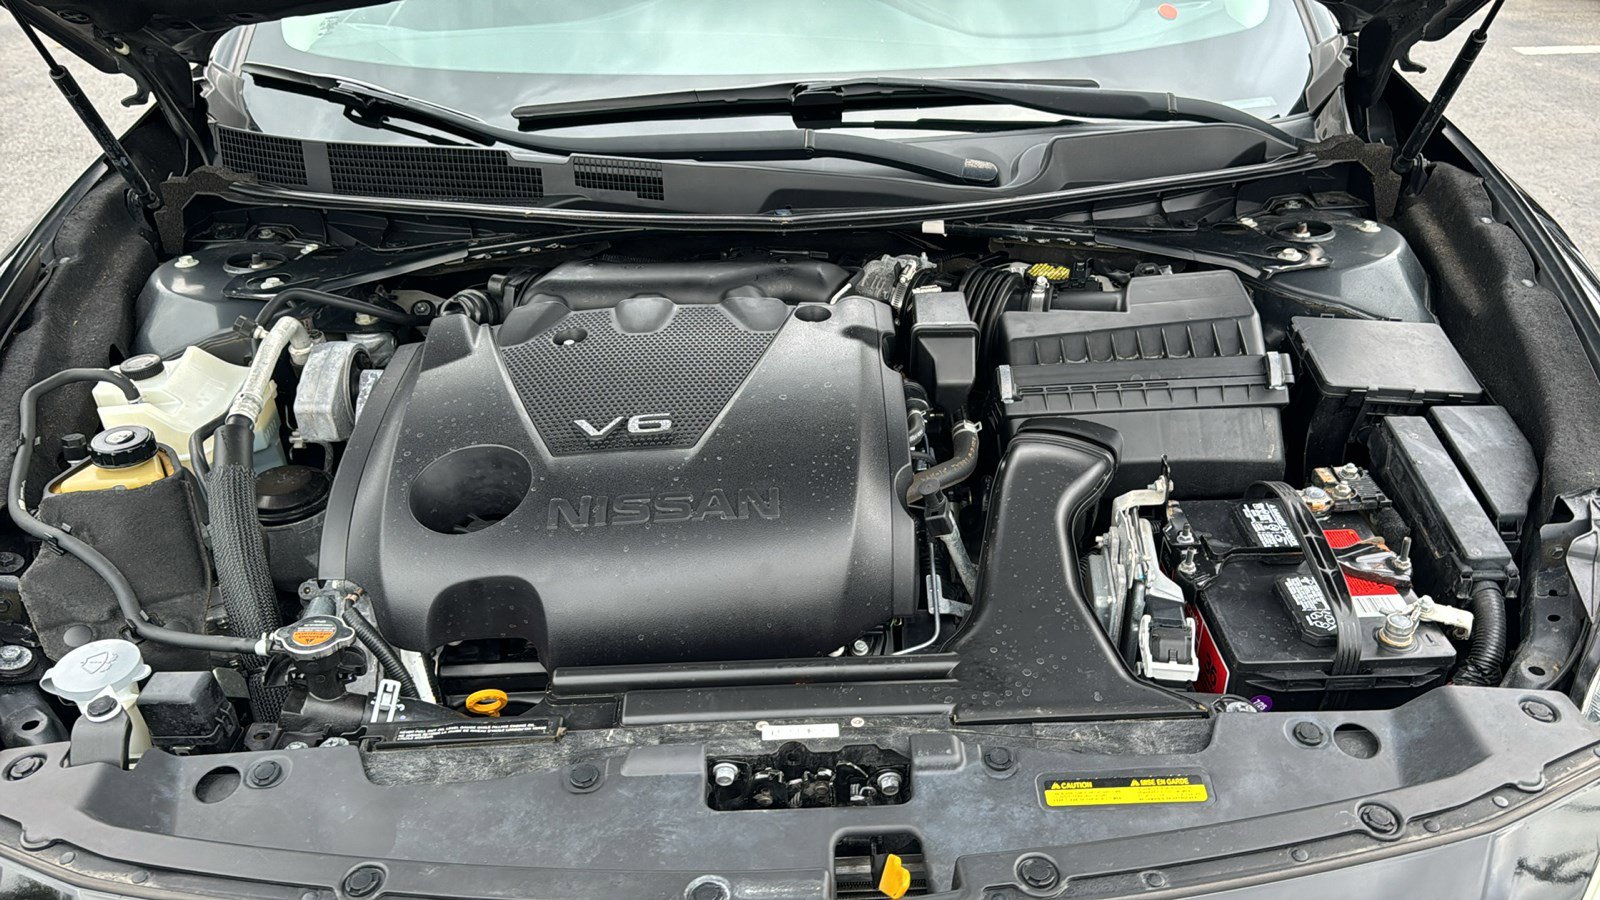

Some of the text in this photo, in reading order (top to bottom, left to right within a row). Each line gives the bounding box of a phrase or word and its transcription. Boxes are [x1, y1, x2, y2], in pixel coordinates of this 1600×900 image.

[573, 412, 673, 439] V6
[546, 487, 781, 531] NISSAN
[1061, 781, 1093, 789] CAUTION
[1167, 777, 1189, 785] GARDE
